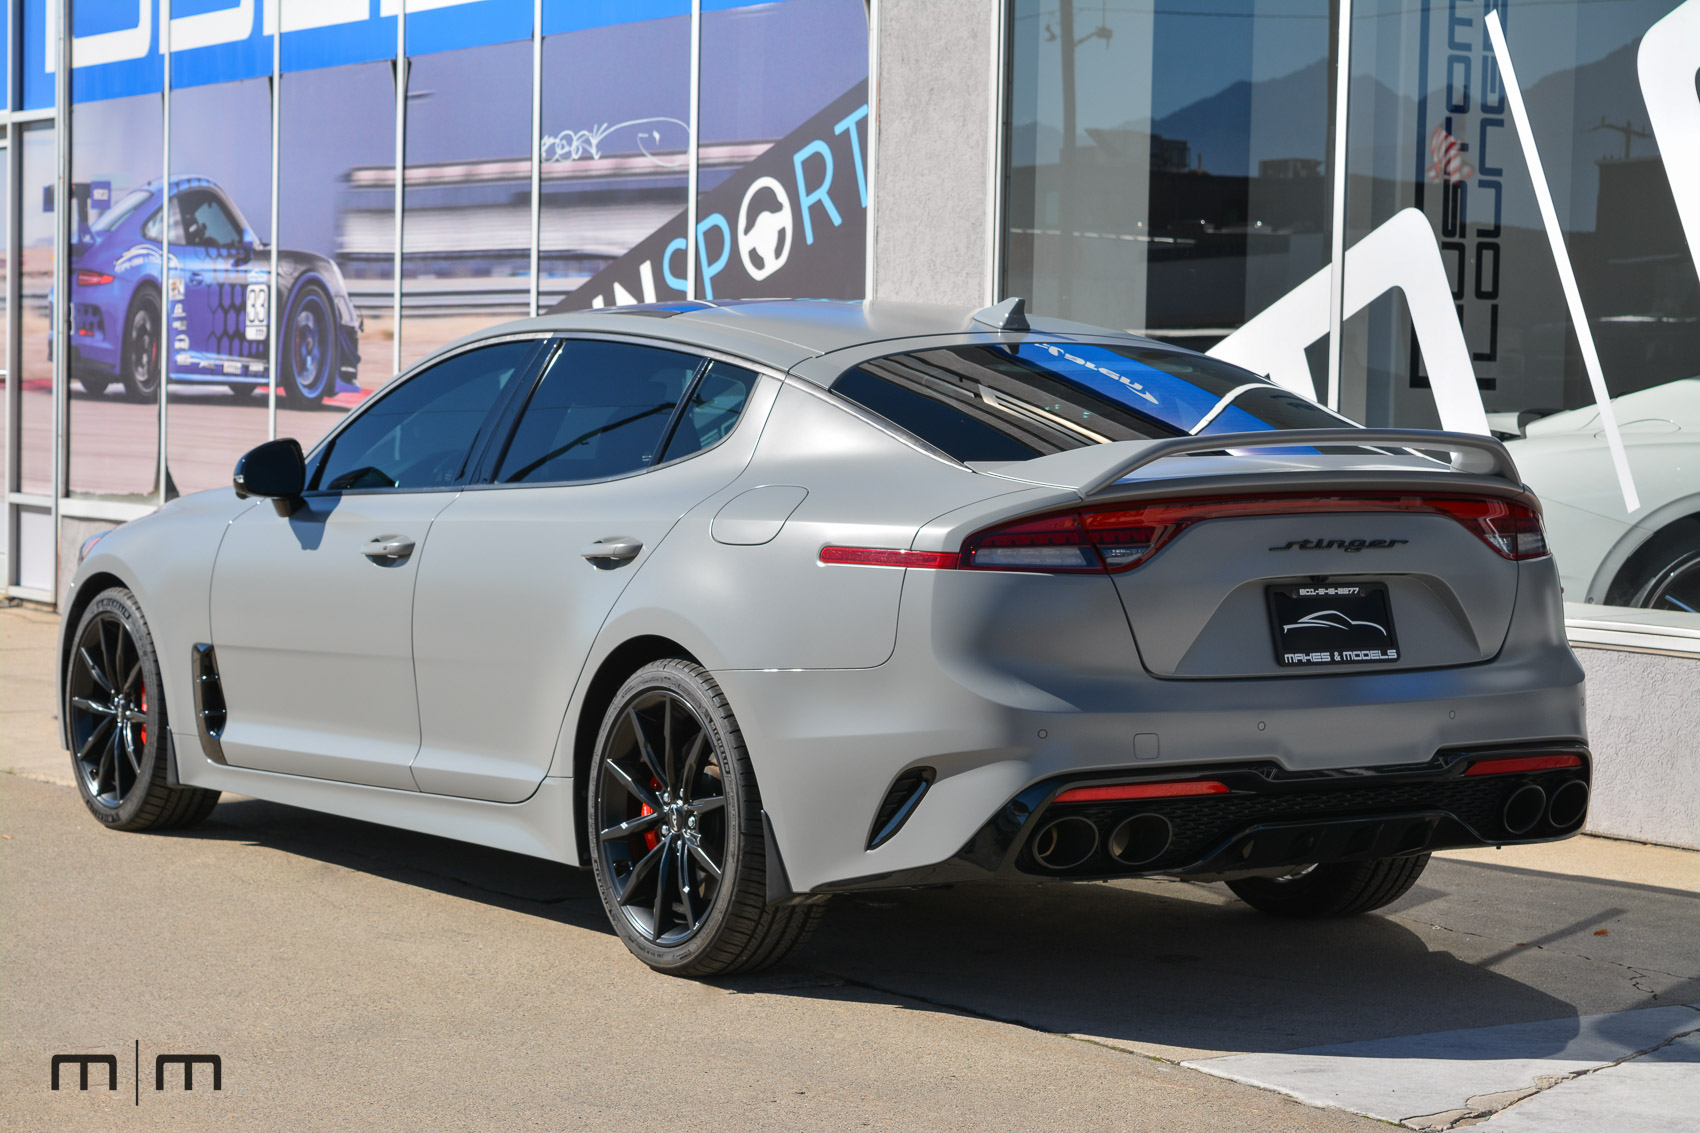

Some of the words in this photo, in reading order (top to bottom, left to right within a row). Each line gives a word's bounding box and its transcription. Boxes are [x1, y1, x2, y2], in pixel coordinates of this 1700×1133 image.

[1441, 0, 1475, 335] USTOM
[248, 289, 265, 323] 33
[1269, 538, 1409, 553] stinger
[1284, 652, 1331, 663] MAKES
[1334, 651, 1341, 662] &
[1343, 649, 1397, 661] MODELS
